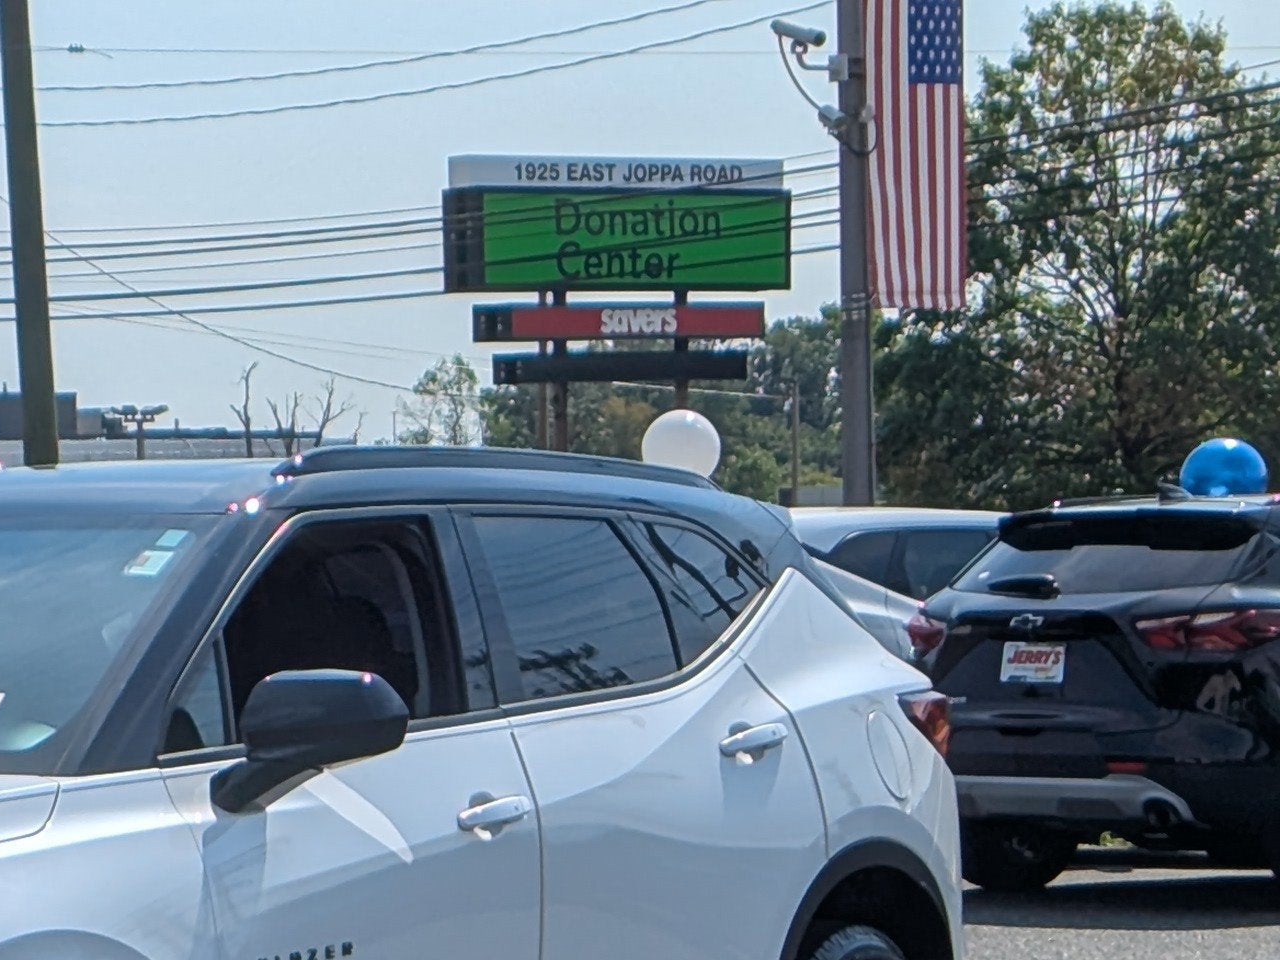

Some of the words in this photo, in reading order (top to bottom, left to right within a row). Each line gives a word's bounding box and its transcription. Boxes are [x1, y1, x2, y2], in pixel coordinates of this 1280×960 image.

[515, 162, 560, 181] 1925
[567, 163, 617, 182] EAST
[623, 163, 684, 183] JOPPA
[690, 164, 743, 183] ROAD
[555, 198, 721, 237] Donation
[556, 240, 680, 279] Center
[601, 308, 677, 333] savers
[1007, 650, 1062, 665] JERRY'S
